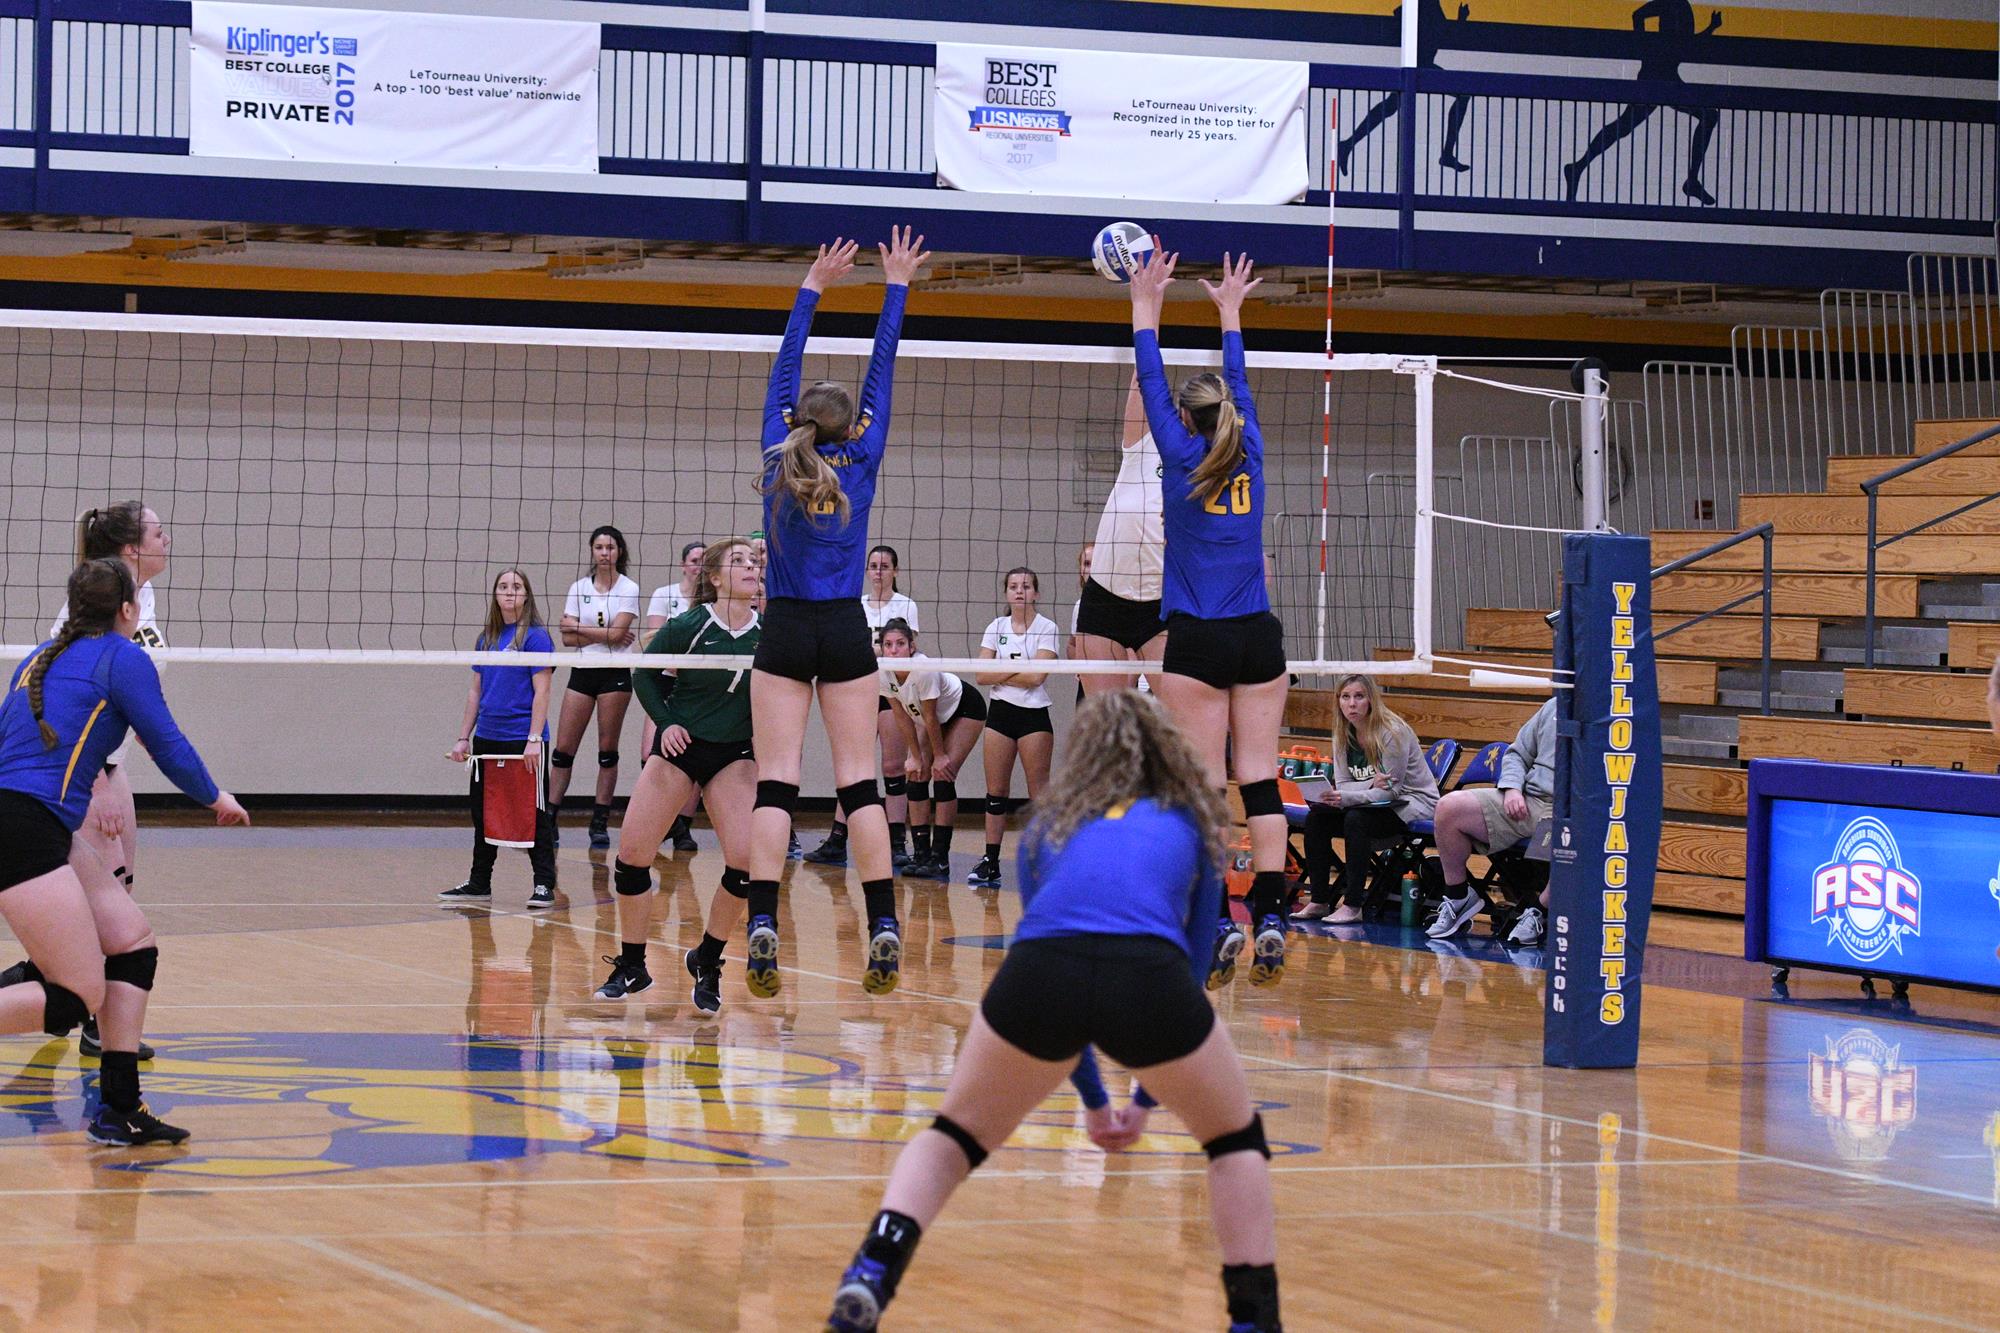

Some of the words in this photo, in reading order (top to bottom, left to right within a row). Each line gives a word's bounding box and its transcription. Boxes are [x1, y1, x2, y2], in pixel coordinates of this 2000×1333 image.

[226, 26, 329, 57] Kiplinger's
[225, 59, 263, 71] BEST
[265, 62, 330, 74] COLLEGE
[409, 69, 480, 82] LeTourneau
[484, 73, 547, 87] University:
[987, 61, 1057, 87] BEST
[224, 74, 332, 99] VALUES
[334, 62, 356, 126] 2017
[373, 83, 383, 92] A
[386, 83, 407, 95] top
[419, 84, 441, 95] 100
[516, 90, 581, 101] nationwide
[986, 87, 1056, 107] COLLEGES
[226, 100, 330, 123] PRIVATE
[1132, 99, 1196, 111] LeTourneau
[1199, 102, 1257, 115] University:
[1113, 112, 1178, 124] Recognized
[1181, 114, 1191, 125] in
[1194, 116, 1211, 126] the
[1214, 117, 1234, 128] top
[1237, 118, 1256, 128] tier
[1259, 119, 1276, 129] for
[1150, 129, 1184, 140] nearly
[1187, 130, 1201, 140] 25
[1204, 131, 1237, 141] years.
[1007, 152, 1033, 164] 2017
[1204, 472, 1252, 515] 20
[727, 667, 745, 693] 7
[1600, 582, 1636, 1025] YELLOWJACKETS
[1814, 863, 1917, 926] ASC
